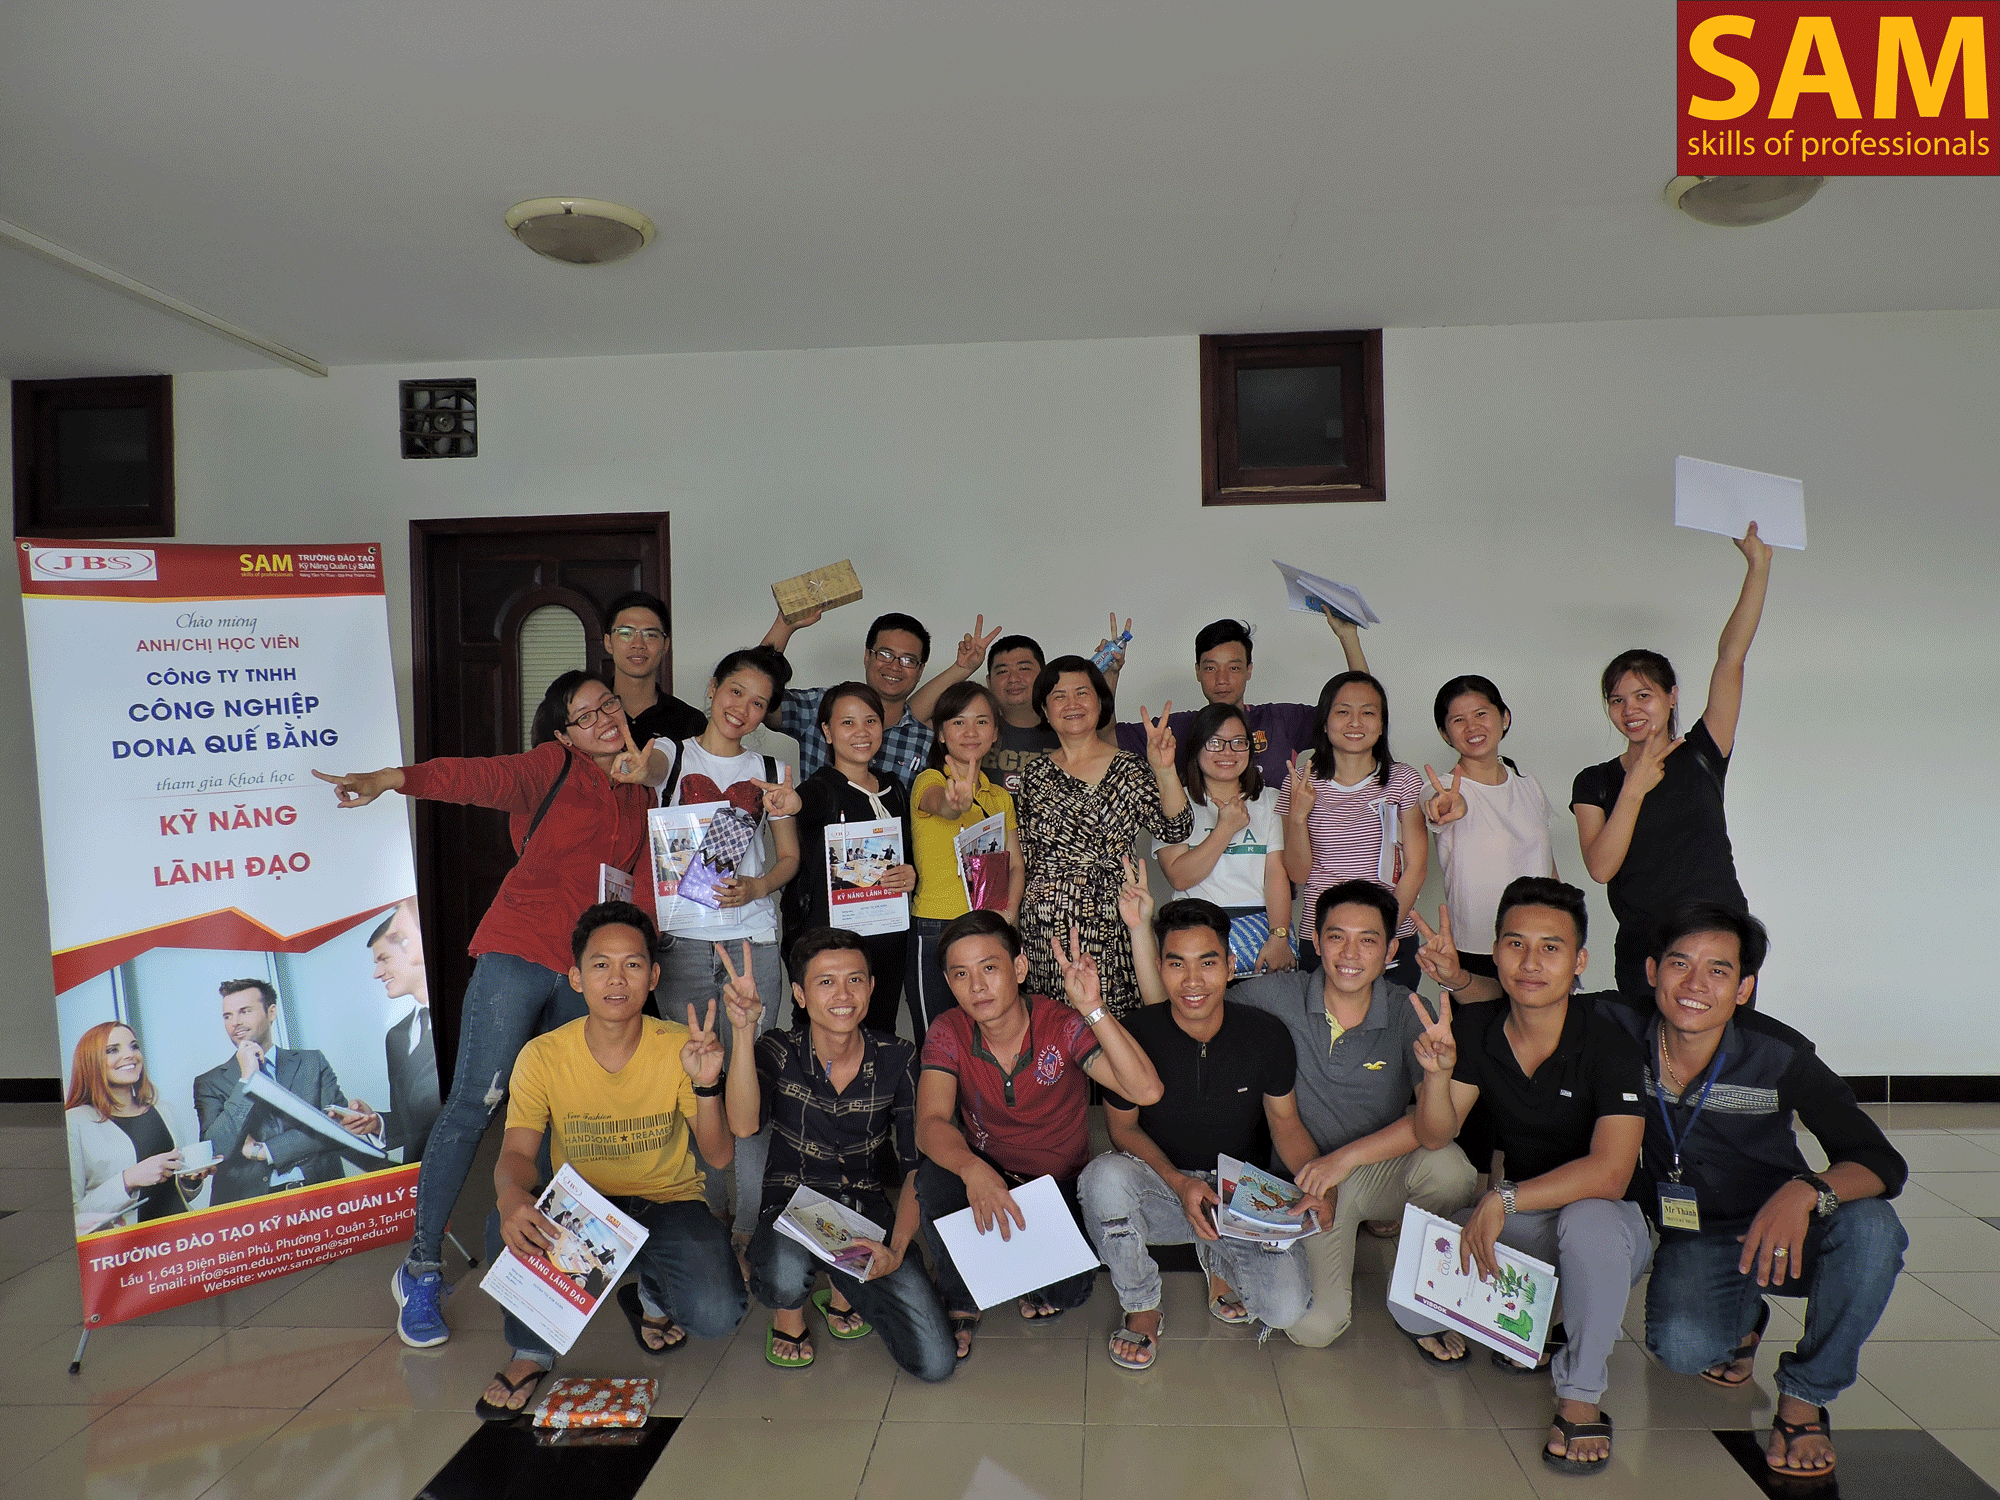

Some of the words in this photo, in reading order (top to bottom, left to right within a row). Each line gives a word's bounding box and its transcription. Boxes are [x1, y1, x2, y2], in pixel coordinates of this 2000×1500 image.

[54, 556, 132, 570] JBS
[240, 554, 293, 571] SAM
[176, 611, 213, 628] Chào
[218, 616, 257, 634] mừng
[136, 638, 212, 653] ANH/CHỊ
[218, 637, 256, 652] HỌC
[261, 635, 300, 649] VIÊN
[146, 667, 212, 686] CÔNG
[217, 669, 239, 683] TY
[245, 668, 296, 682] TNHH
[128, 697, 215, 722] CÔNG
[224, 692, 319, 719] NGHIỆP
[112, 737, 196, 759] DONA
[205, 724, 260, 753] QUẾ
[266, 722, 338, 750] BẰNG
[156, 778, 196, 791] tham
[197, 776, 223, 792] gia
[228, 772, 265, 788] khoá
[269, 770, 296, 784] học
[160, 808, 198, 836] KỸ
[209, 804, 297, 832] NĂNG
[154, 859, 235, 887] LÃNH
[245, 852, 311, 881] ĐẠO
[583, 1112, 612, 1120] Fashion
[564, 1135, 617, 1144] HANDSOME
[90, 1242, 171, 1272] TRƯỜNG
[176, 1232, 215, 1252] ĐÀO
[219, 1223, 255, 1242] TẠO
[259, 1215, 281, 1233] KỸ
[286, 1205, 333, 1227] NĂNG
[337, 1195, 382, 1215] QUẢN
[387, 1187, 405, 1204] LÝ
[147, 1271, 158, 1282] 1,
[160, 1264, 183, 1278] 643
[186, 1257, 215, 1272] Điện
[218, 1250, 244, 1264] Biên
[247, 1243, 273, 1257] Phủ,
[276, 1232, 321, 1250] Phường
[324, 1229, 334, 1238] 1,
[336, 1218, 366, 1234] Quận
[369, 1217, 378, 1228] 3,
[149, 1277, 187, 1294] Email:
[189, 1252, 293, 1285] info@sam.edu.vn;
[296, 1225, 398, 1257] tuvan@sam.edu.vn
[203, 1272, 255, 1293] Website:
[257, 1248, 352, 1279] www.sam.edu.vn
[528, 1256, 550, 1275] NĂNG
